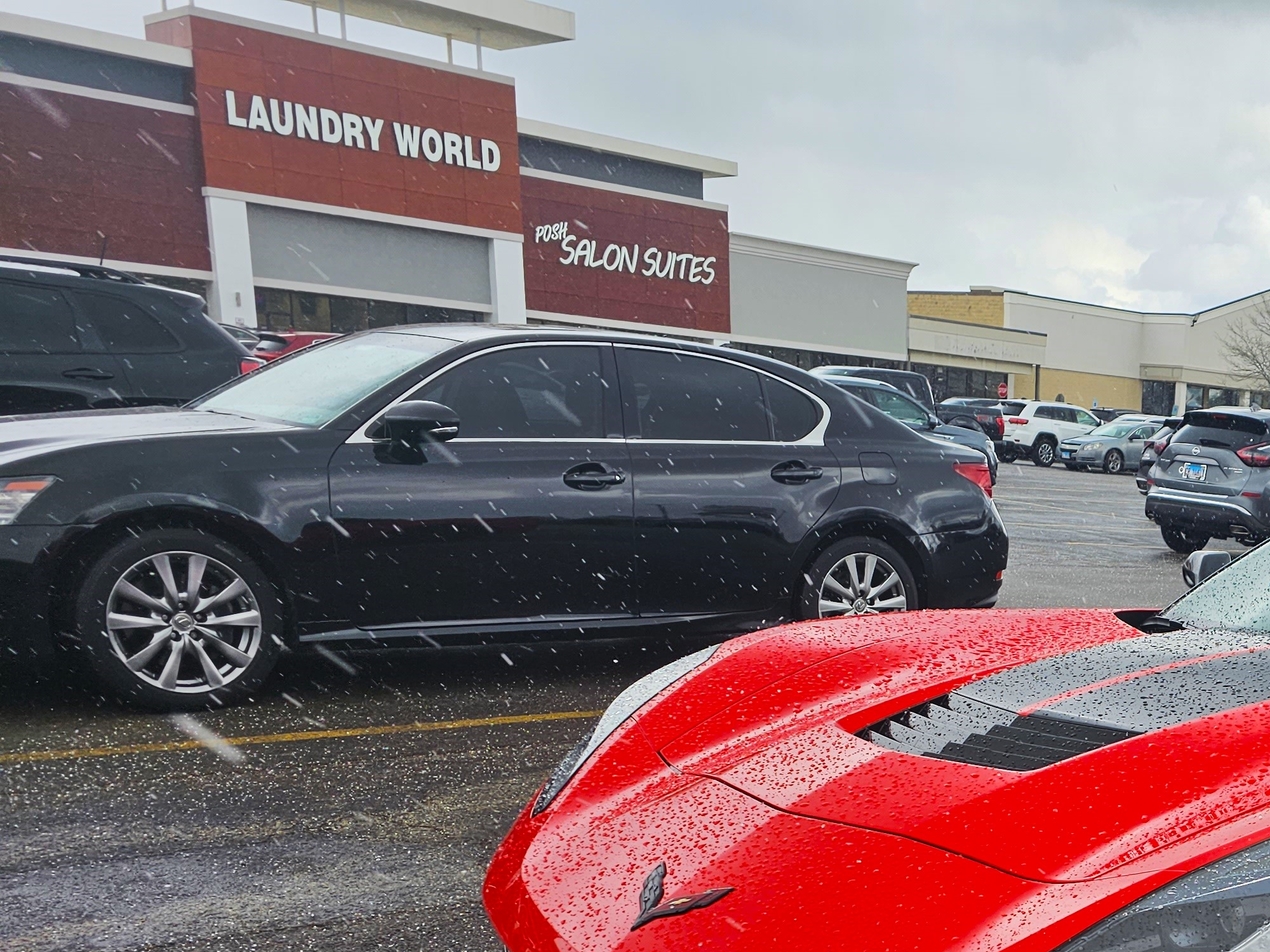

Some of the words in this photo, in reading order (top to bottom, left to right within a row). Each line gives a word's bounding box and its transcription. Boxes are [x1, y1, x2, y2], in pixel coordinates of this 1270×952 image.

[225, 89, 384, 151] LAUNDRY
[393, 122, 501, 172] WORLD
[535, 221, 568, 243] POSH
[559, 234, 639, 273] SALON
[641, 247, 717, 285] SUITES
